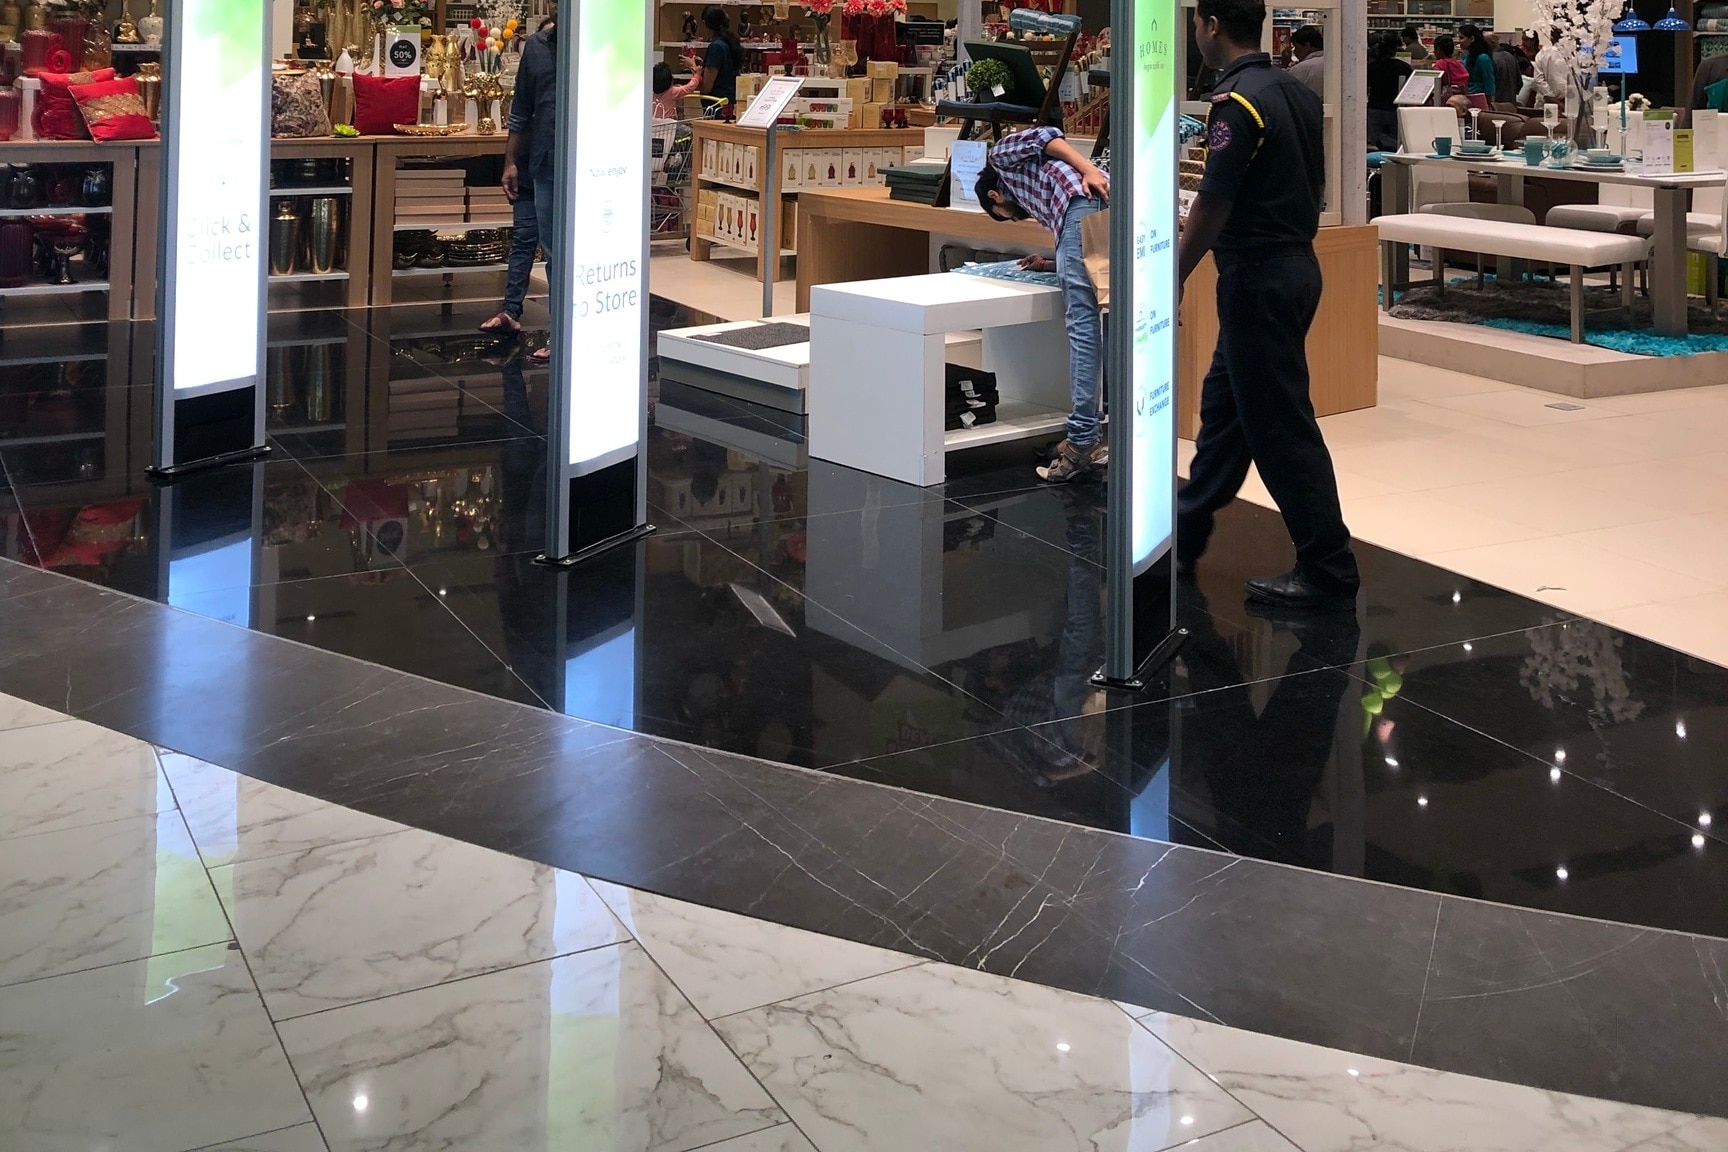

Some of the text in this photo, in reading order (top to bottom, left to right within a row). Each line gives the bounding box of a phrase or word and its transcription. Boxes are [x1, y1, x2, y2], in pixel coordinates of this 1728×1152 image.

[393, 50, 413, 59] 50%
[1139, 40, 1168, 58] HOMES
[237, 213, 251, 234] &
[1136, 245, 1146, 259] EMI
[1150, 238, 1170, 254] FURNITURE
[575, 259, 637, 286] Returns
[595, 289, 637, 315] Store
[1150, 317, 1170, 335] FURNITURE
[1150, 380, 1170, 401] FURNITURE
[1149, 395, 1170, 417] EXCHANGE
